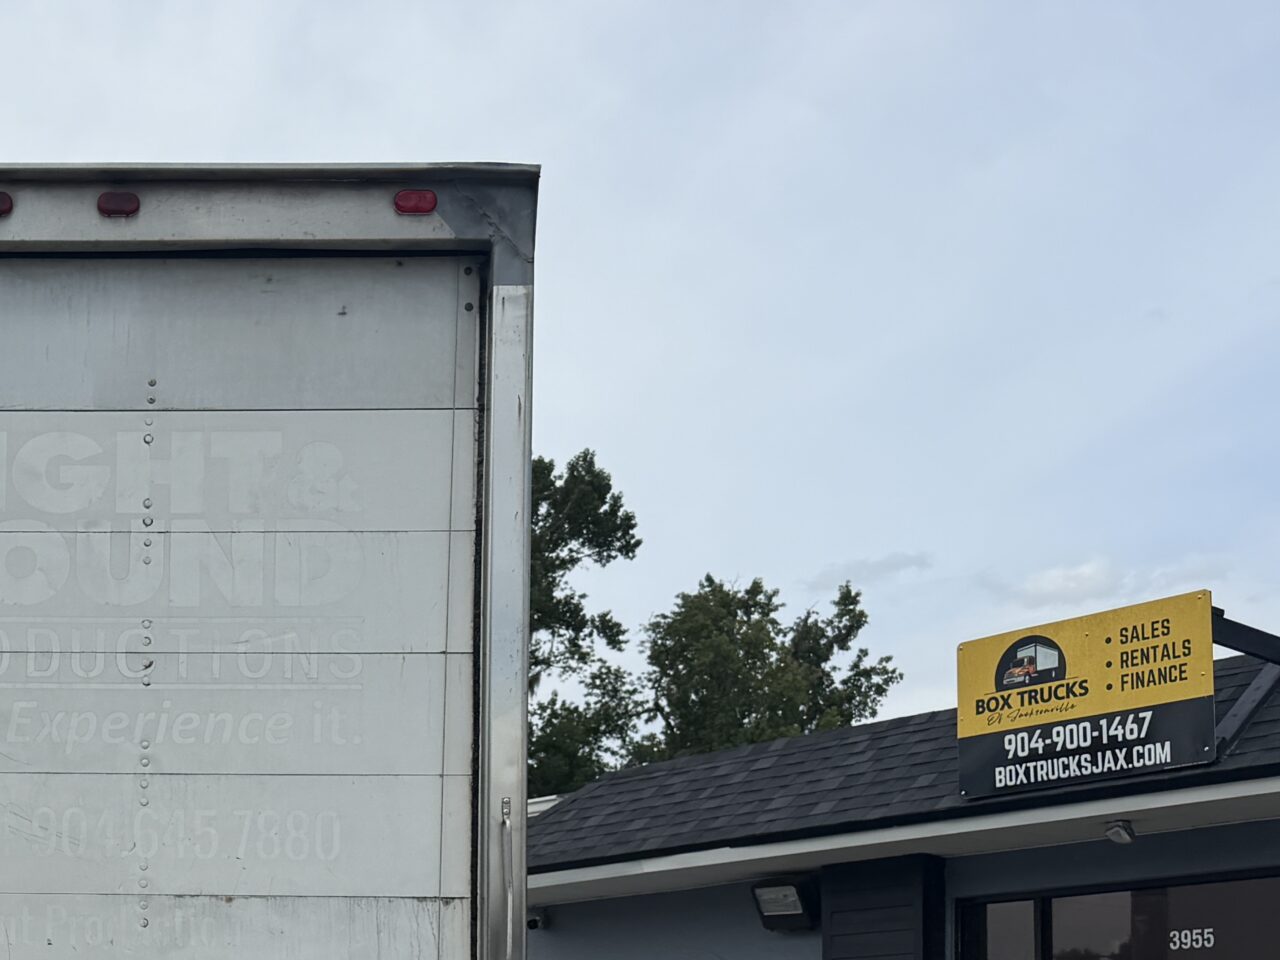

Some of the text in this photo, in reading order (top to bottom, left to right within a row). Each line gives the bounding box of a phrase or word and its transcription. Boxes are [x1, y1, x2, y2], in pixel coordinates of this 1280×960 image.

[288, 440, 363, 513] &
[1119, 618, 1170, 645] SALES
[1120, 639, 1191, 669] RENTALS
[1120, 663, 1188, 692] FINANCE
[975, 679, 1090, 716] BOX TRUCKS
[6, 701, 294, 754] Experience
[312, 701, 363, 745] it.
[1004, 711, 1153, 760] 904-900-1467
[995, 741, 1171, 789] BOXTRUCKSJAX.COM
[1170, 928, 1215, 950] 3955
